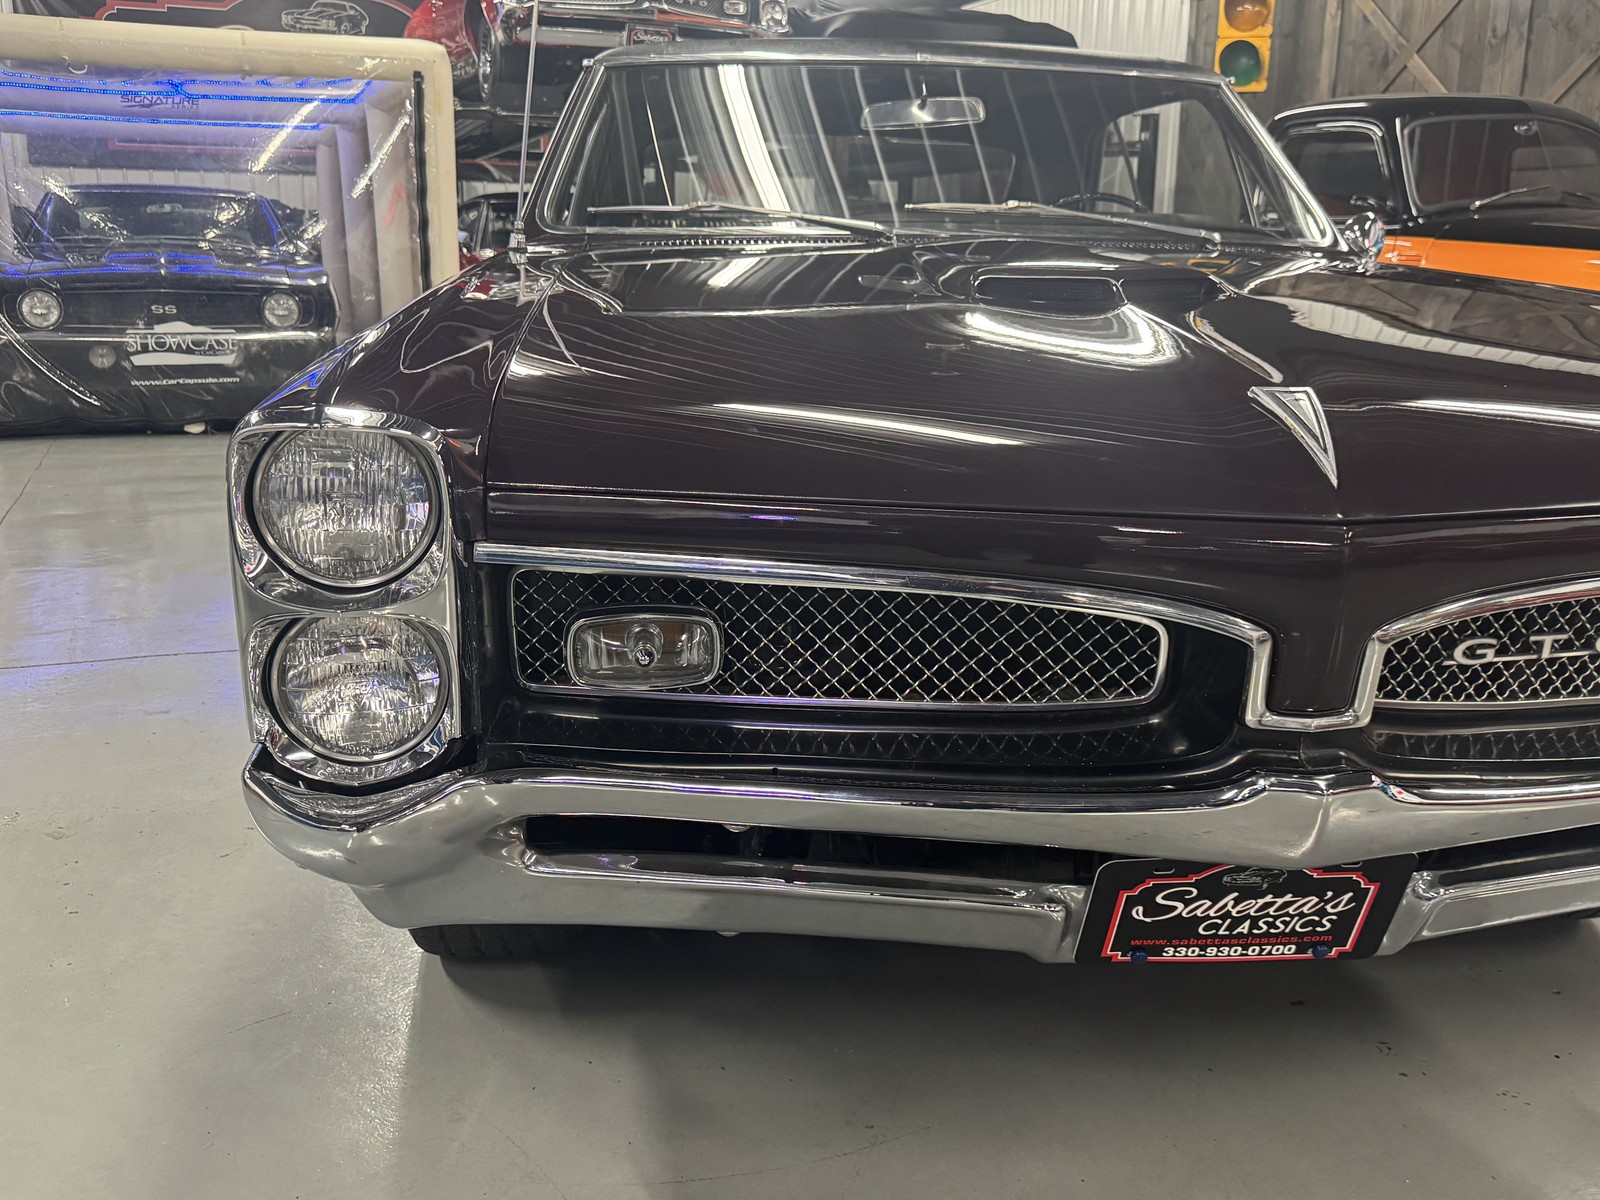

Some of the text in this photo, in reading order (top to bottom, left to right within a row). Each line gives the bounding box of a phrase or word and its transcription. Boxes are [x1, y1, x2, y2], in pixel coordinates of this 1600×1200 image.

[120, 95, 200, 105] SIGNATURE
[151, 304, 178, 315] SS
[126, 333, 239, 353] SHOWCASE
[1453, 633, 1600, 666] GT
[1131, 886, 1356, 923] Sabetta's
[1198, 915, 1338, 936] CLASSICS
[1130, 934, 1333, 946] www.sabettasclassics.com
[1162, 944, 1297, 957] 330-930-0700
